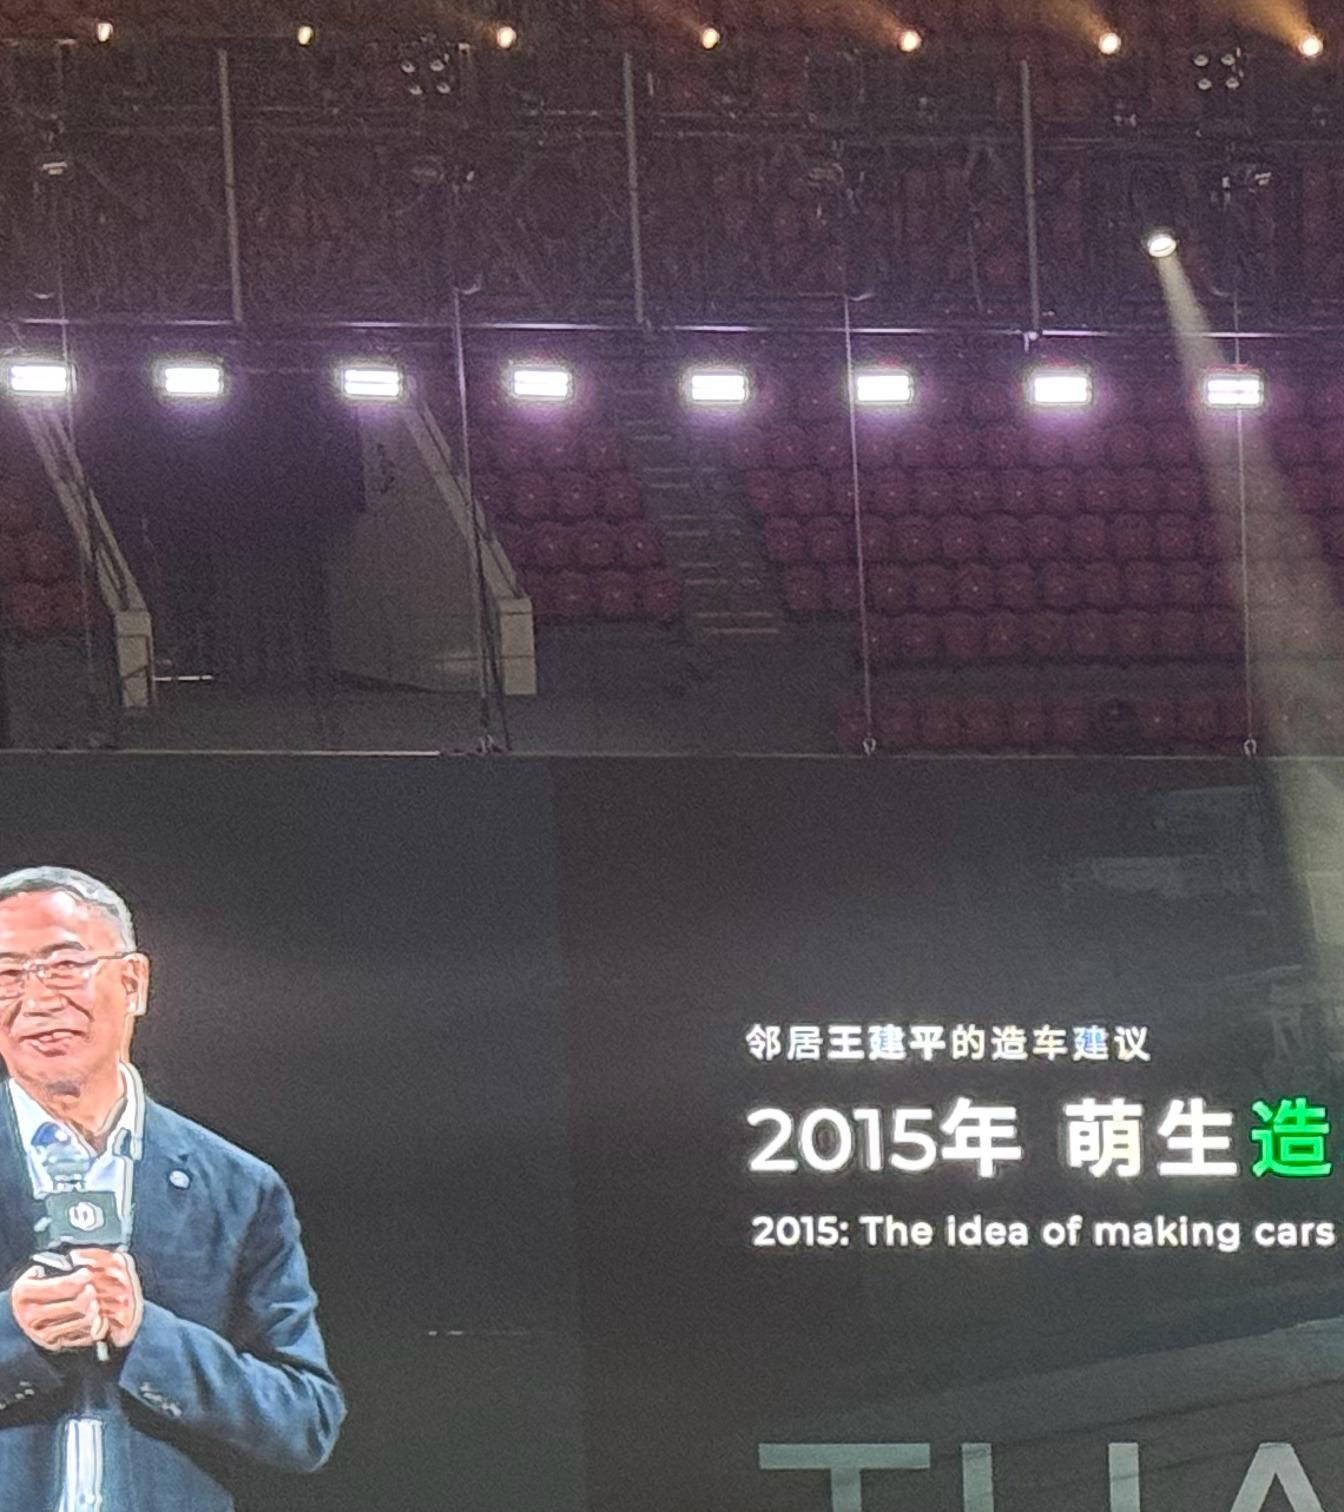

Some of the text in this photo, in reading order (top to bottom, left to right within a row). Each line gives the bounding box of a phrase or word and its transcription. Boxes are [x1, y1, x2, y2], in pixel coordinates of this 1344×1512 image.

[744, 1022, 1152, 1063] 邻居王建平的造车建议
[745, 1095, 1024, 1180] 2015年
[751, 1214, 849, 1247] 2015:
[858, 1214, 934, 1247] The
[946, 1213, 1029, 1247] idea
[1041, 1213, 1083, 1247] of
[1093, 1213, 1241, 1254] making
[1253, 1220, 1336, 1247] cars
